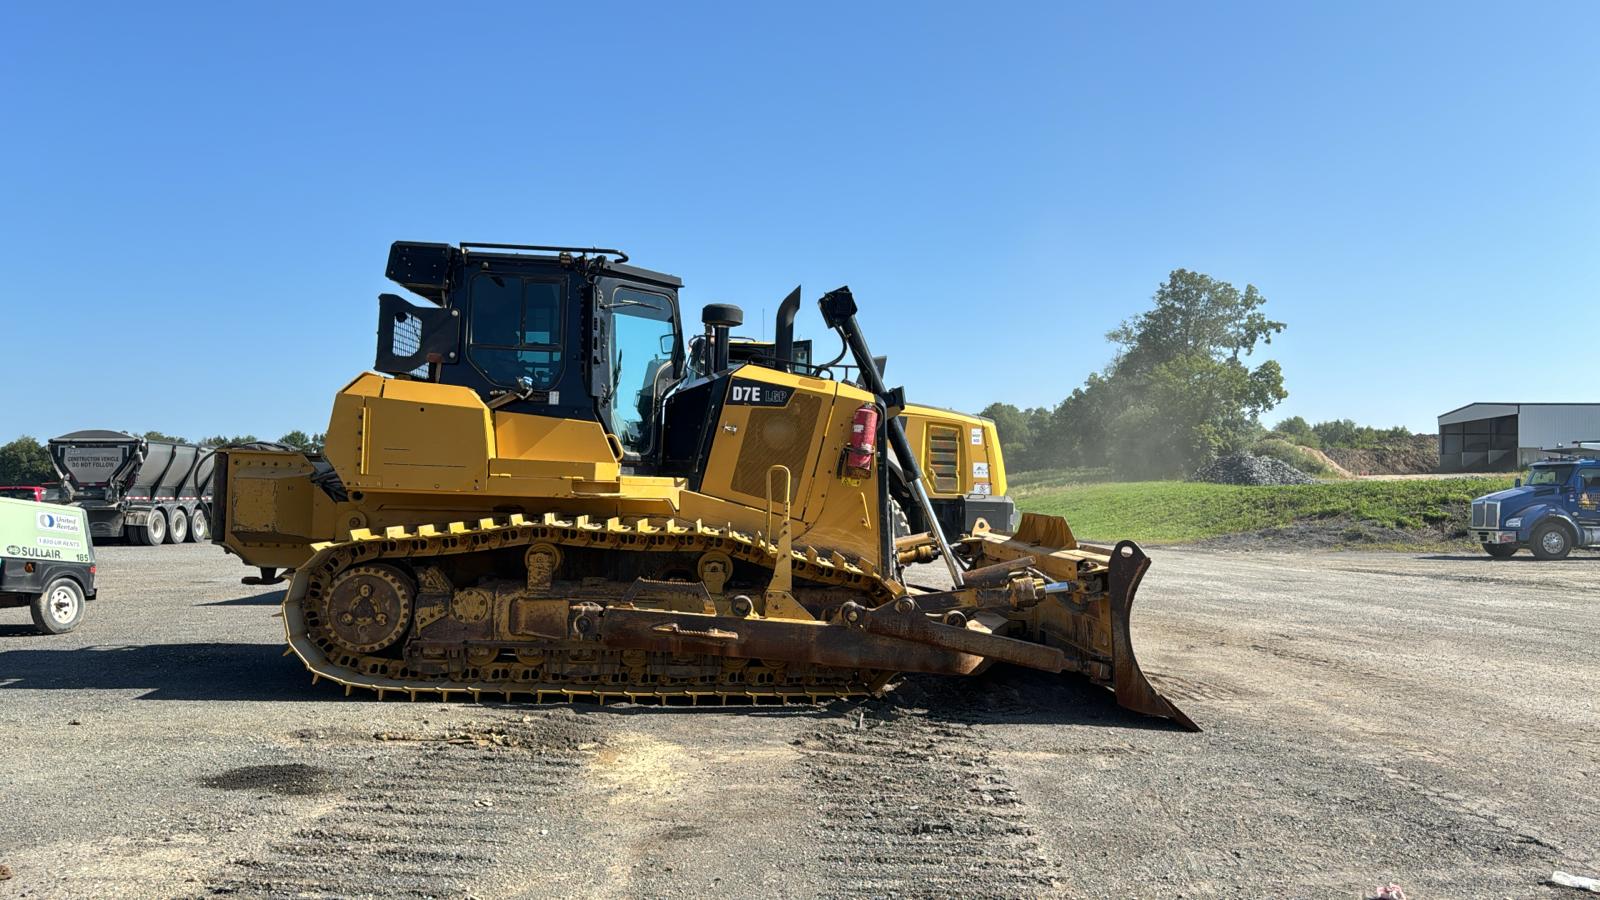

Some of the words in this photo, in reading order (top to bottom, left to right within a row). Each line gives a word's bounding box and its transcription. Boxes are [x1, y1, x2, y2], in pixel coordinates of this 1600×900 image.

[732, 386, 760, 401] D7E
[56, 515, 77, 524] United
[56, 523, 79, 531] Rentals
[21, 546, 61, 559] SULLAIR
[76, 554, 89, 562] 185
